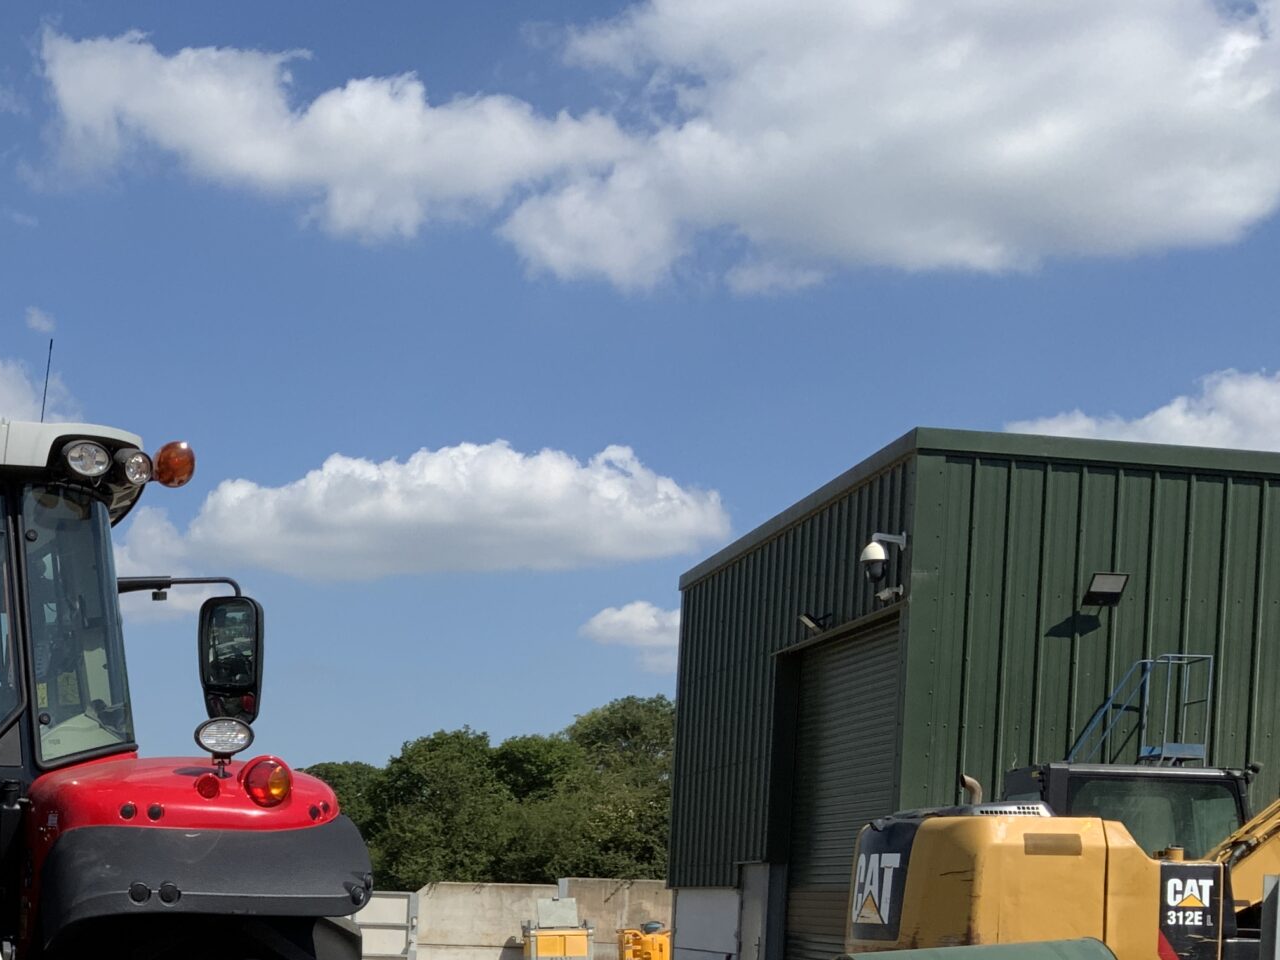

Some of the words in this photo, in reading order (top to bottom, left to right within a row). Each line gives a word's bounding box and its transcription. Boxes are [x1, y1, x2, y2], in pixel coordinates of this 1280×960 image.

[852, 852, 901, 925] CAT
[1167, 878, 1214, 907] CAT
[1167, 910, 1203, 926] 312E
